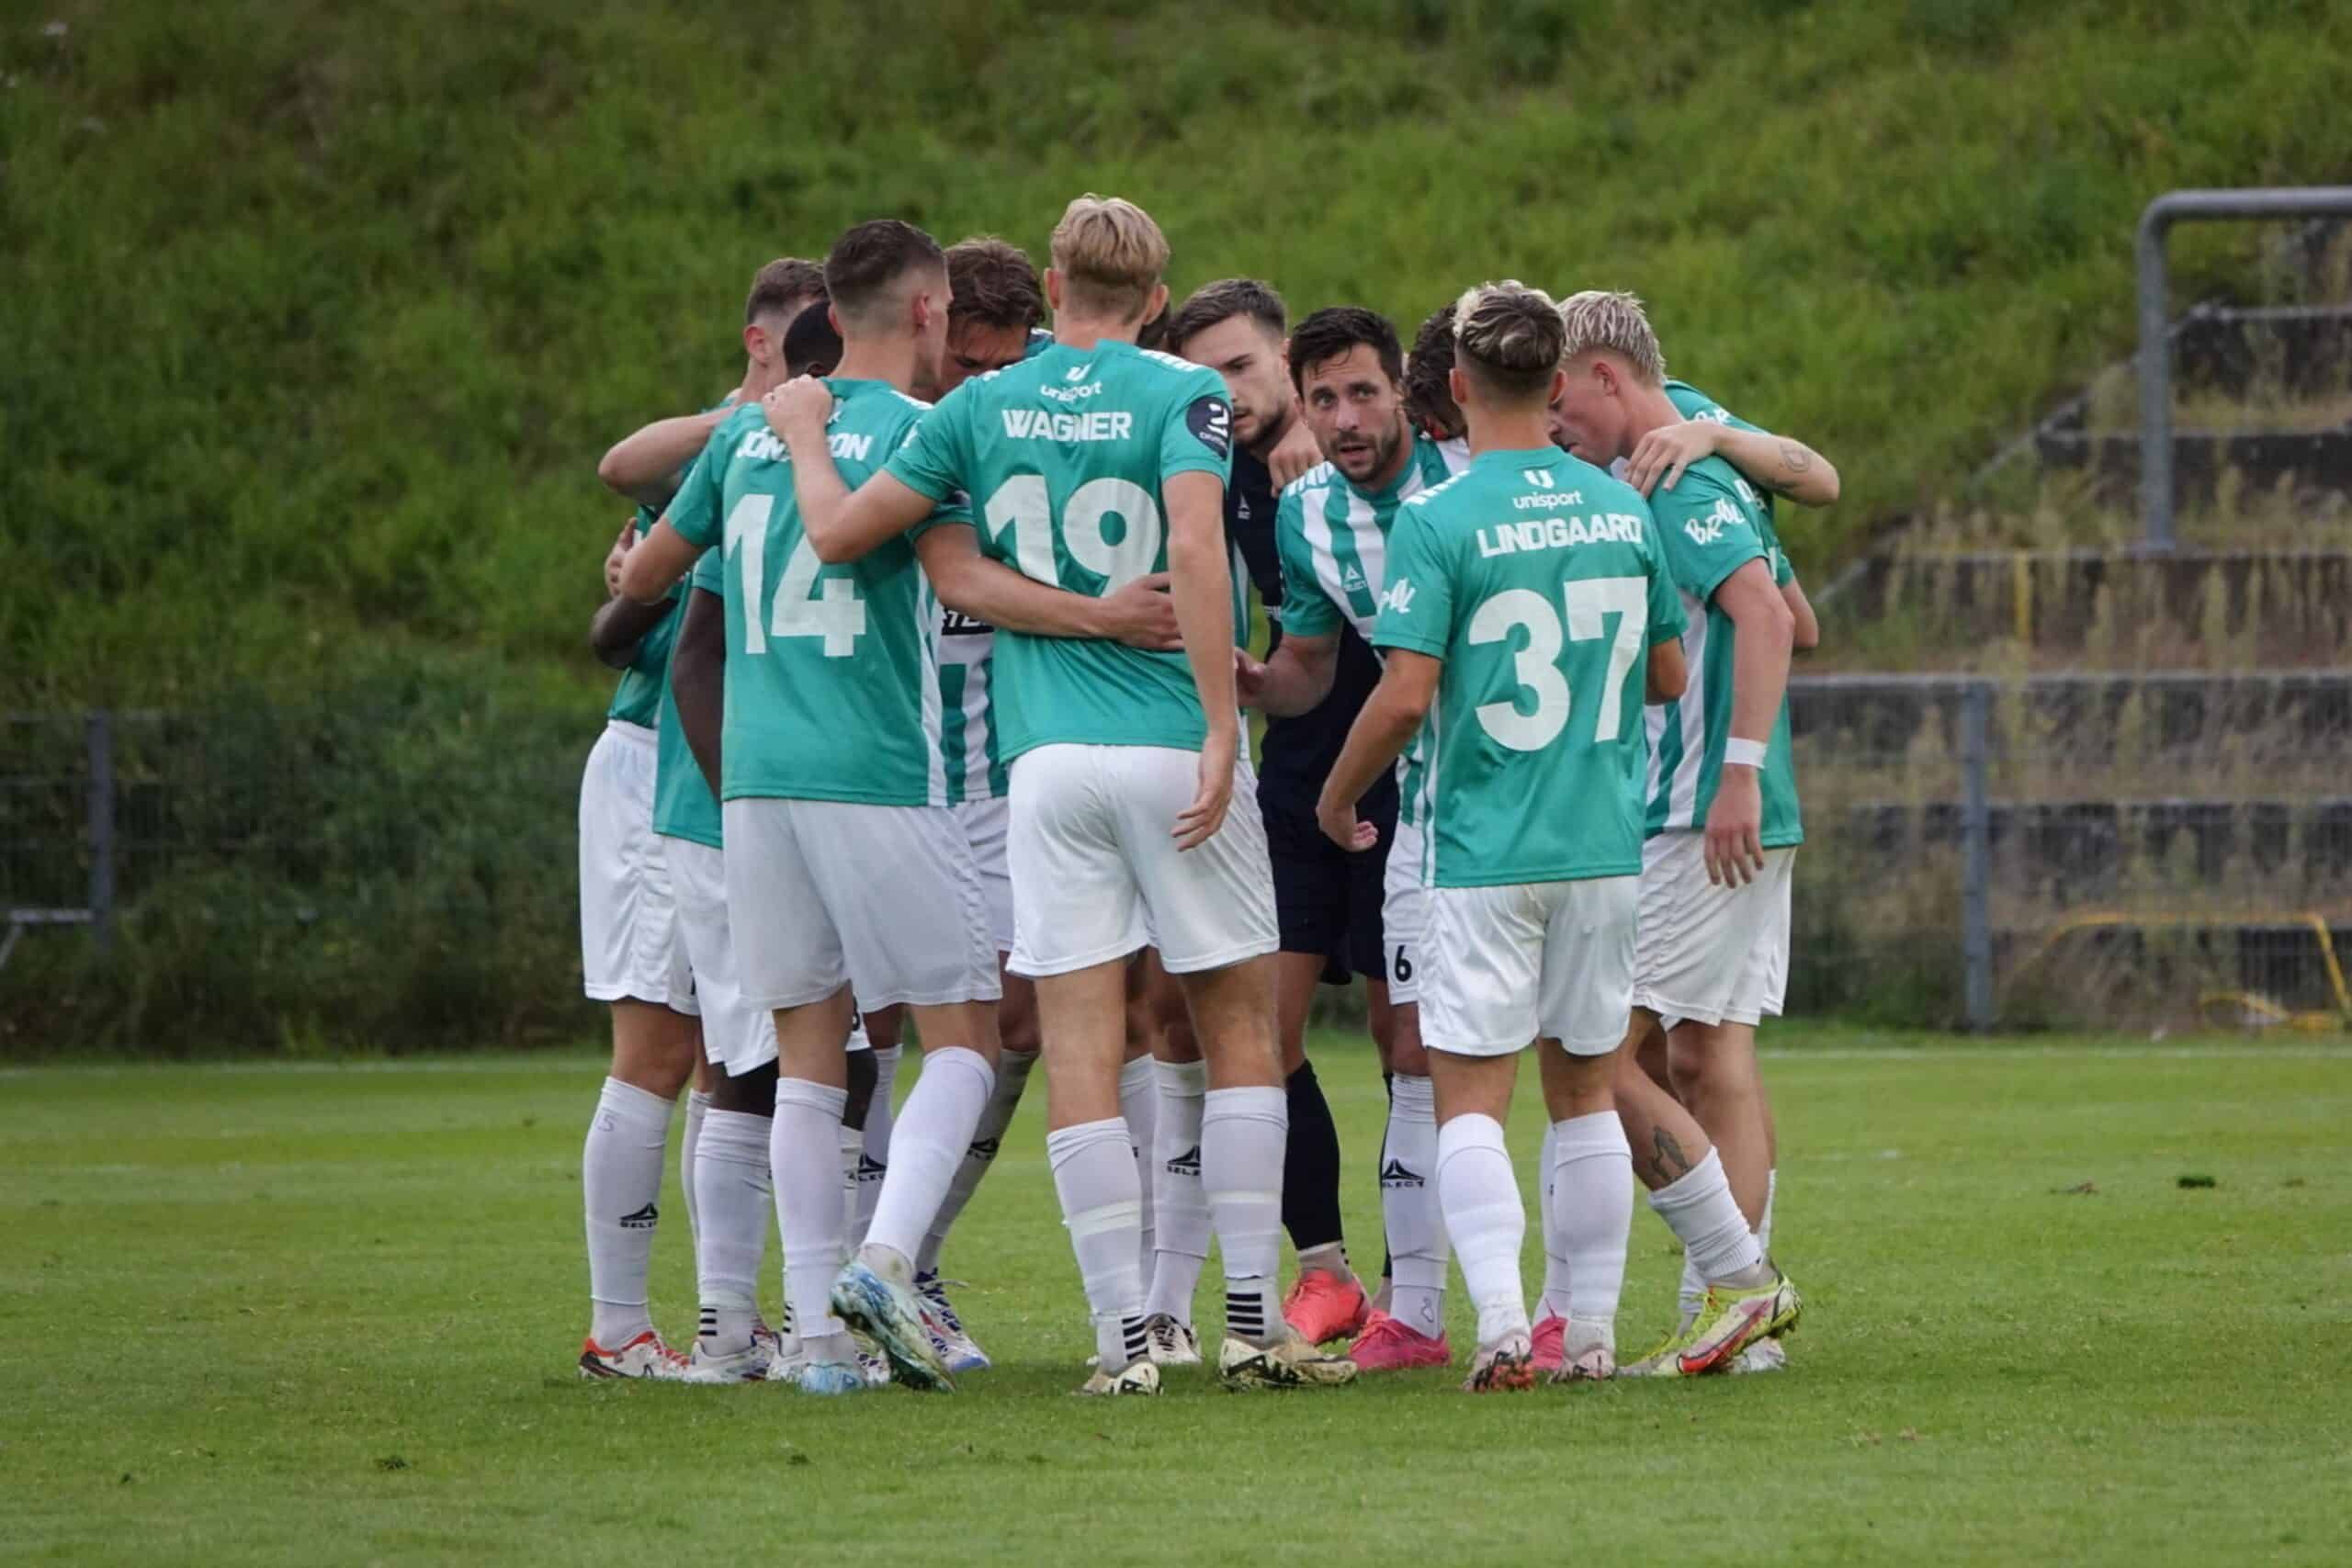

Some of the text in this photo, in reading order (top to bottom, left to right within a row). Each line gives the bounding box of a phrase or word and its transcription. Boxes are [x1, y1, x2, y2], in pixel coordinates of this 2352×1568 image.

[736, 425, 872, 461] JÓNON
[1001, 410, 1133, 442] WAGNER
[1513, 490, 1584, 511] unisport
[984, 474, 1162, 598] 19
[1476, 513, 1643, 558] LINDGAARD
[724, 493, 866, 657] 14
[1468, 575, 1644, 752] 37
[1395, 944, 1412, 982] 6
